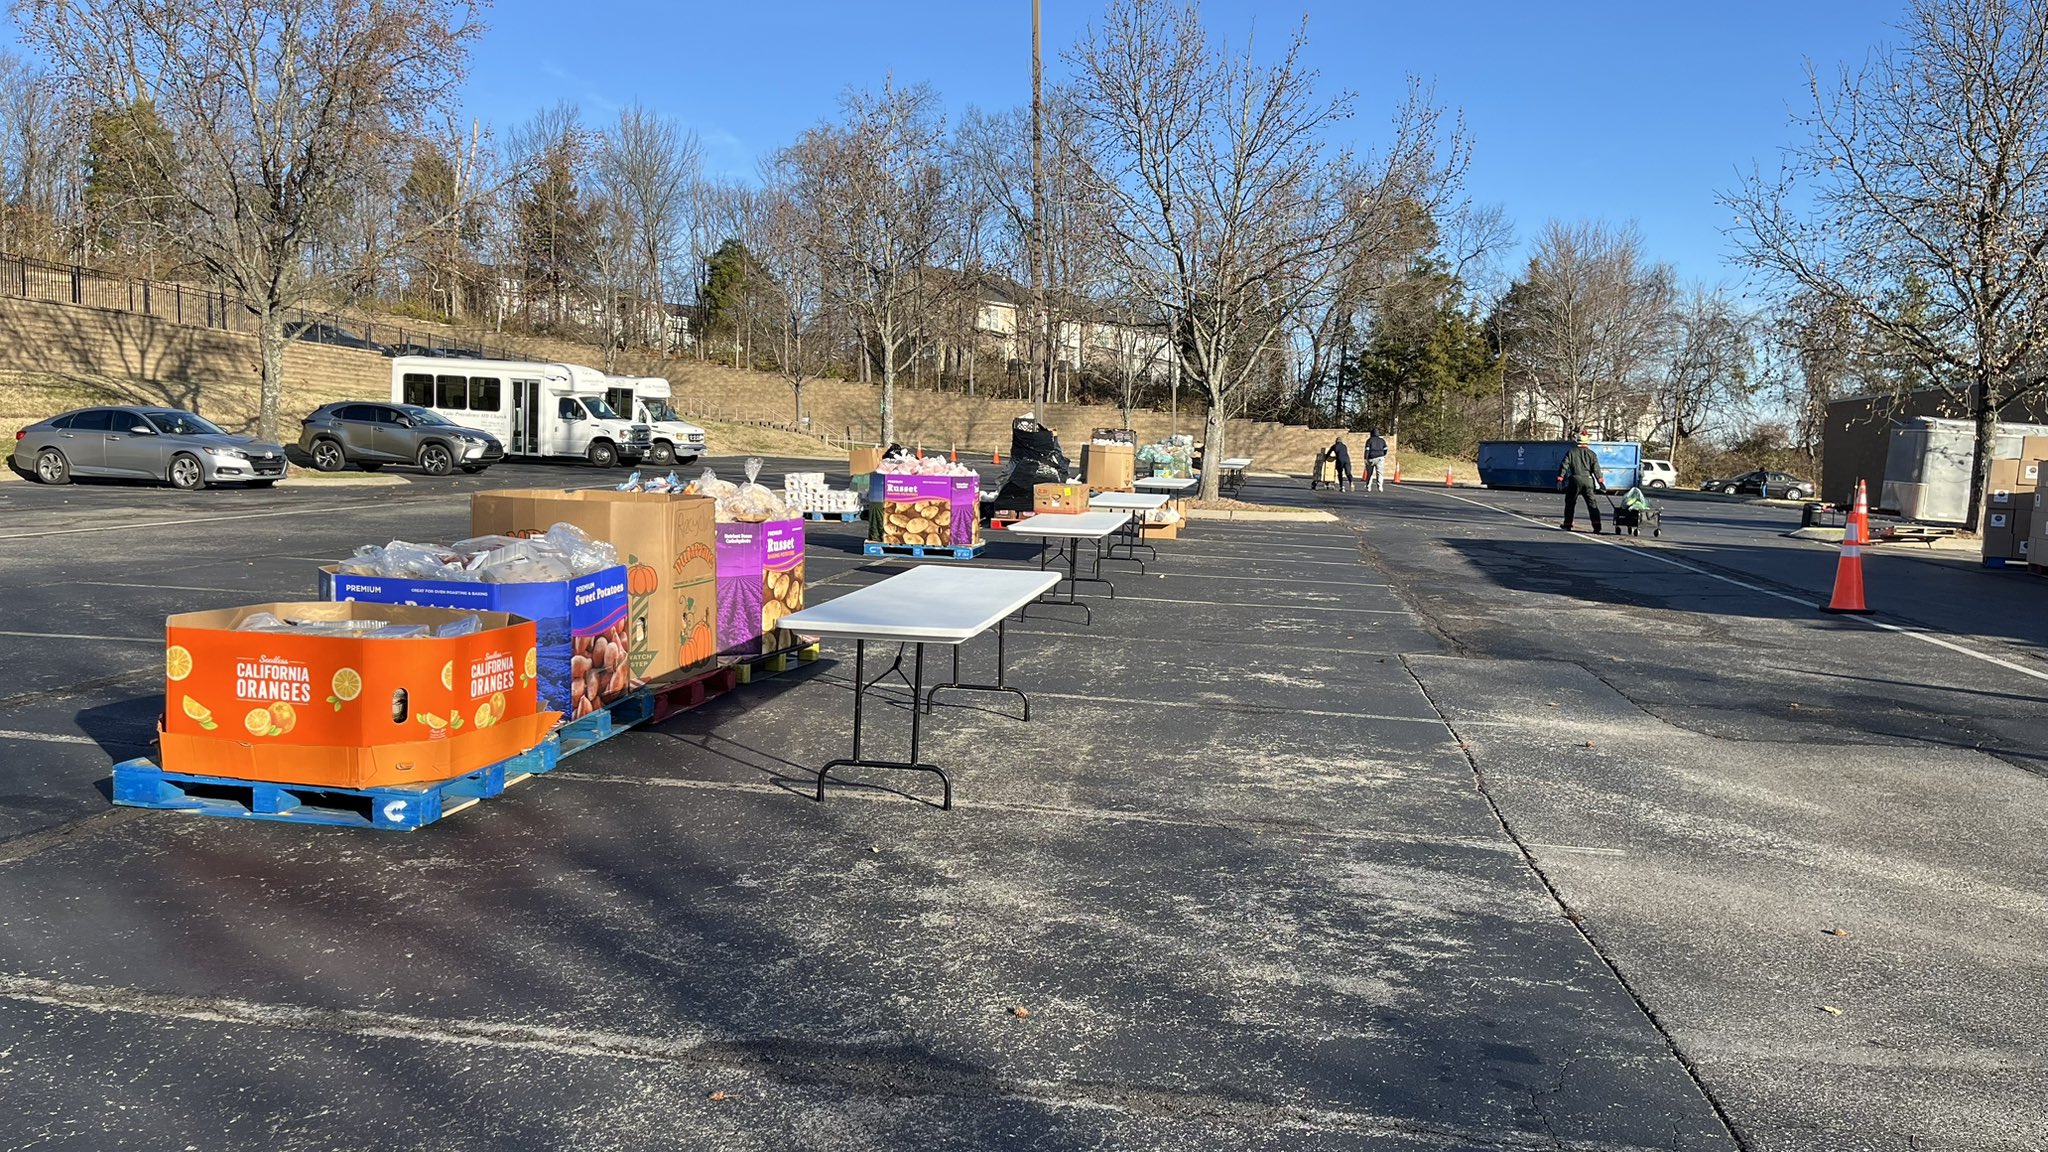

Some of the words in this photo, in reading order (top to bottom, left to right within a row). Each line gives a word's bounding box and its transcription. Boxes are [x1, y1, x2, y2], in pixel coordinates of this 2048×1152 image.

[887, 484, 918, 493] Russet
[767, 537, 795, 553] Russet
[345, 584, 382, 593] PREMIUM
[575, 581, 595, 593] PREMIUM
[575, 591, 596, 607] Sweet
[596, 583, 624, 600] Potatoes
[259, 654, 289, 665] Seedless
[470, 655, 514, 679] CALIFORNIA
[236, 662, 310, 682] CALIFORNIA
[236, 678, 311, 703] ORANGES
[470, 670, 515, 698] ORANGES
